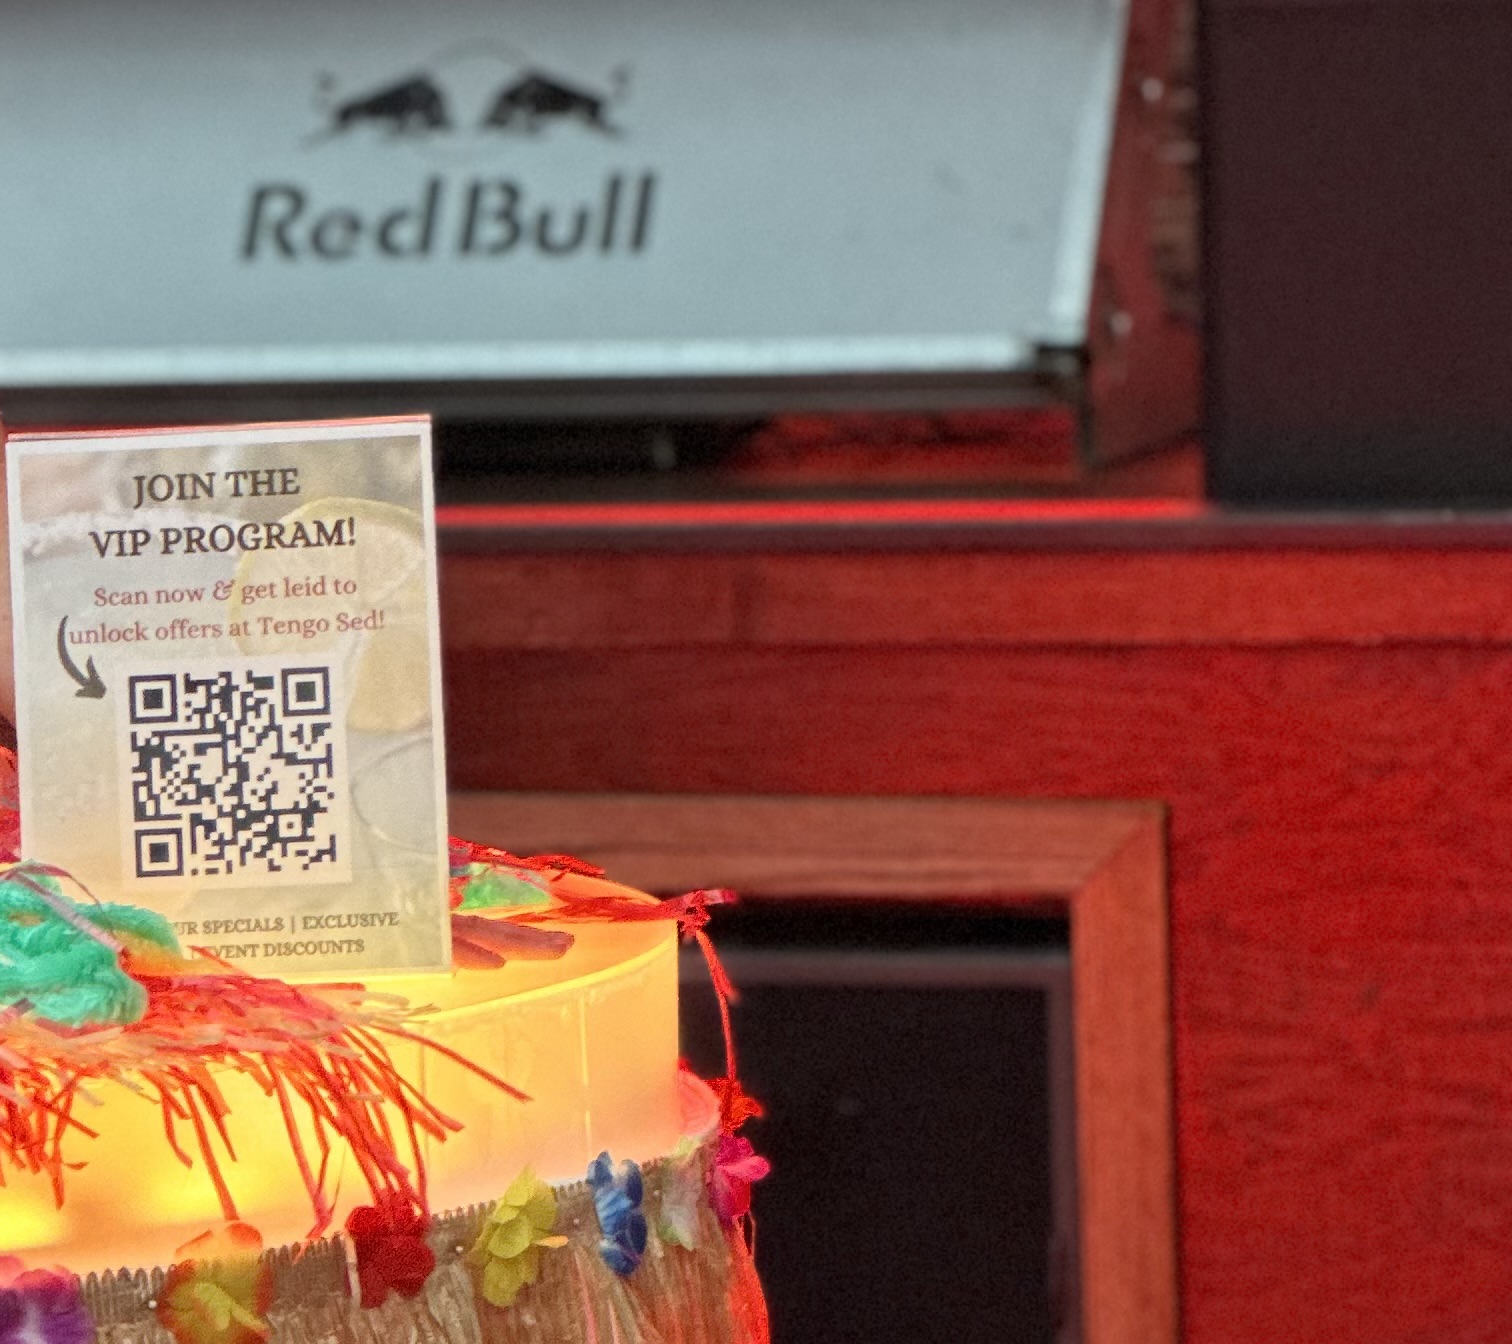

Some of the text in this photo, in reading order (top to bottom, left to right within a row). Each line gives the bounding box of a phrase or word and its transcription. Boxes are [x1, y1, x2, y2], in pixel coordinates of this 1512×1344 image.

[133, 468, 300, 509] JOIN THE
[88, 517, 356, 558] VIP PROGRAM!
[94, 576, 357, 607] Scan now & get leid to
[69, 609, 385, 644] unlock offers at Tengo Sed!
[202, 917, 285, 935] SPECIALS
[302, 912, 400, 930] EXCLUSIVE
[203, 939, 364, 959] VENT DISCOUNTS
